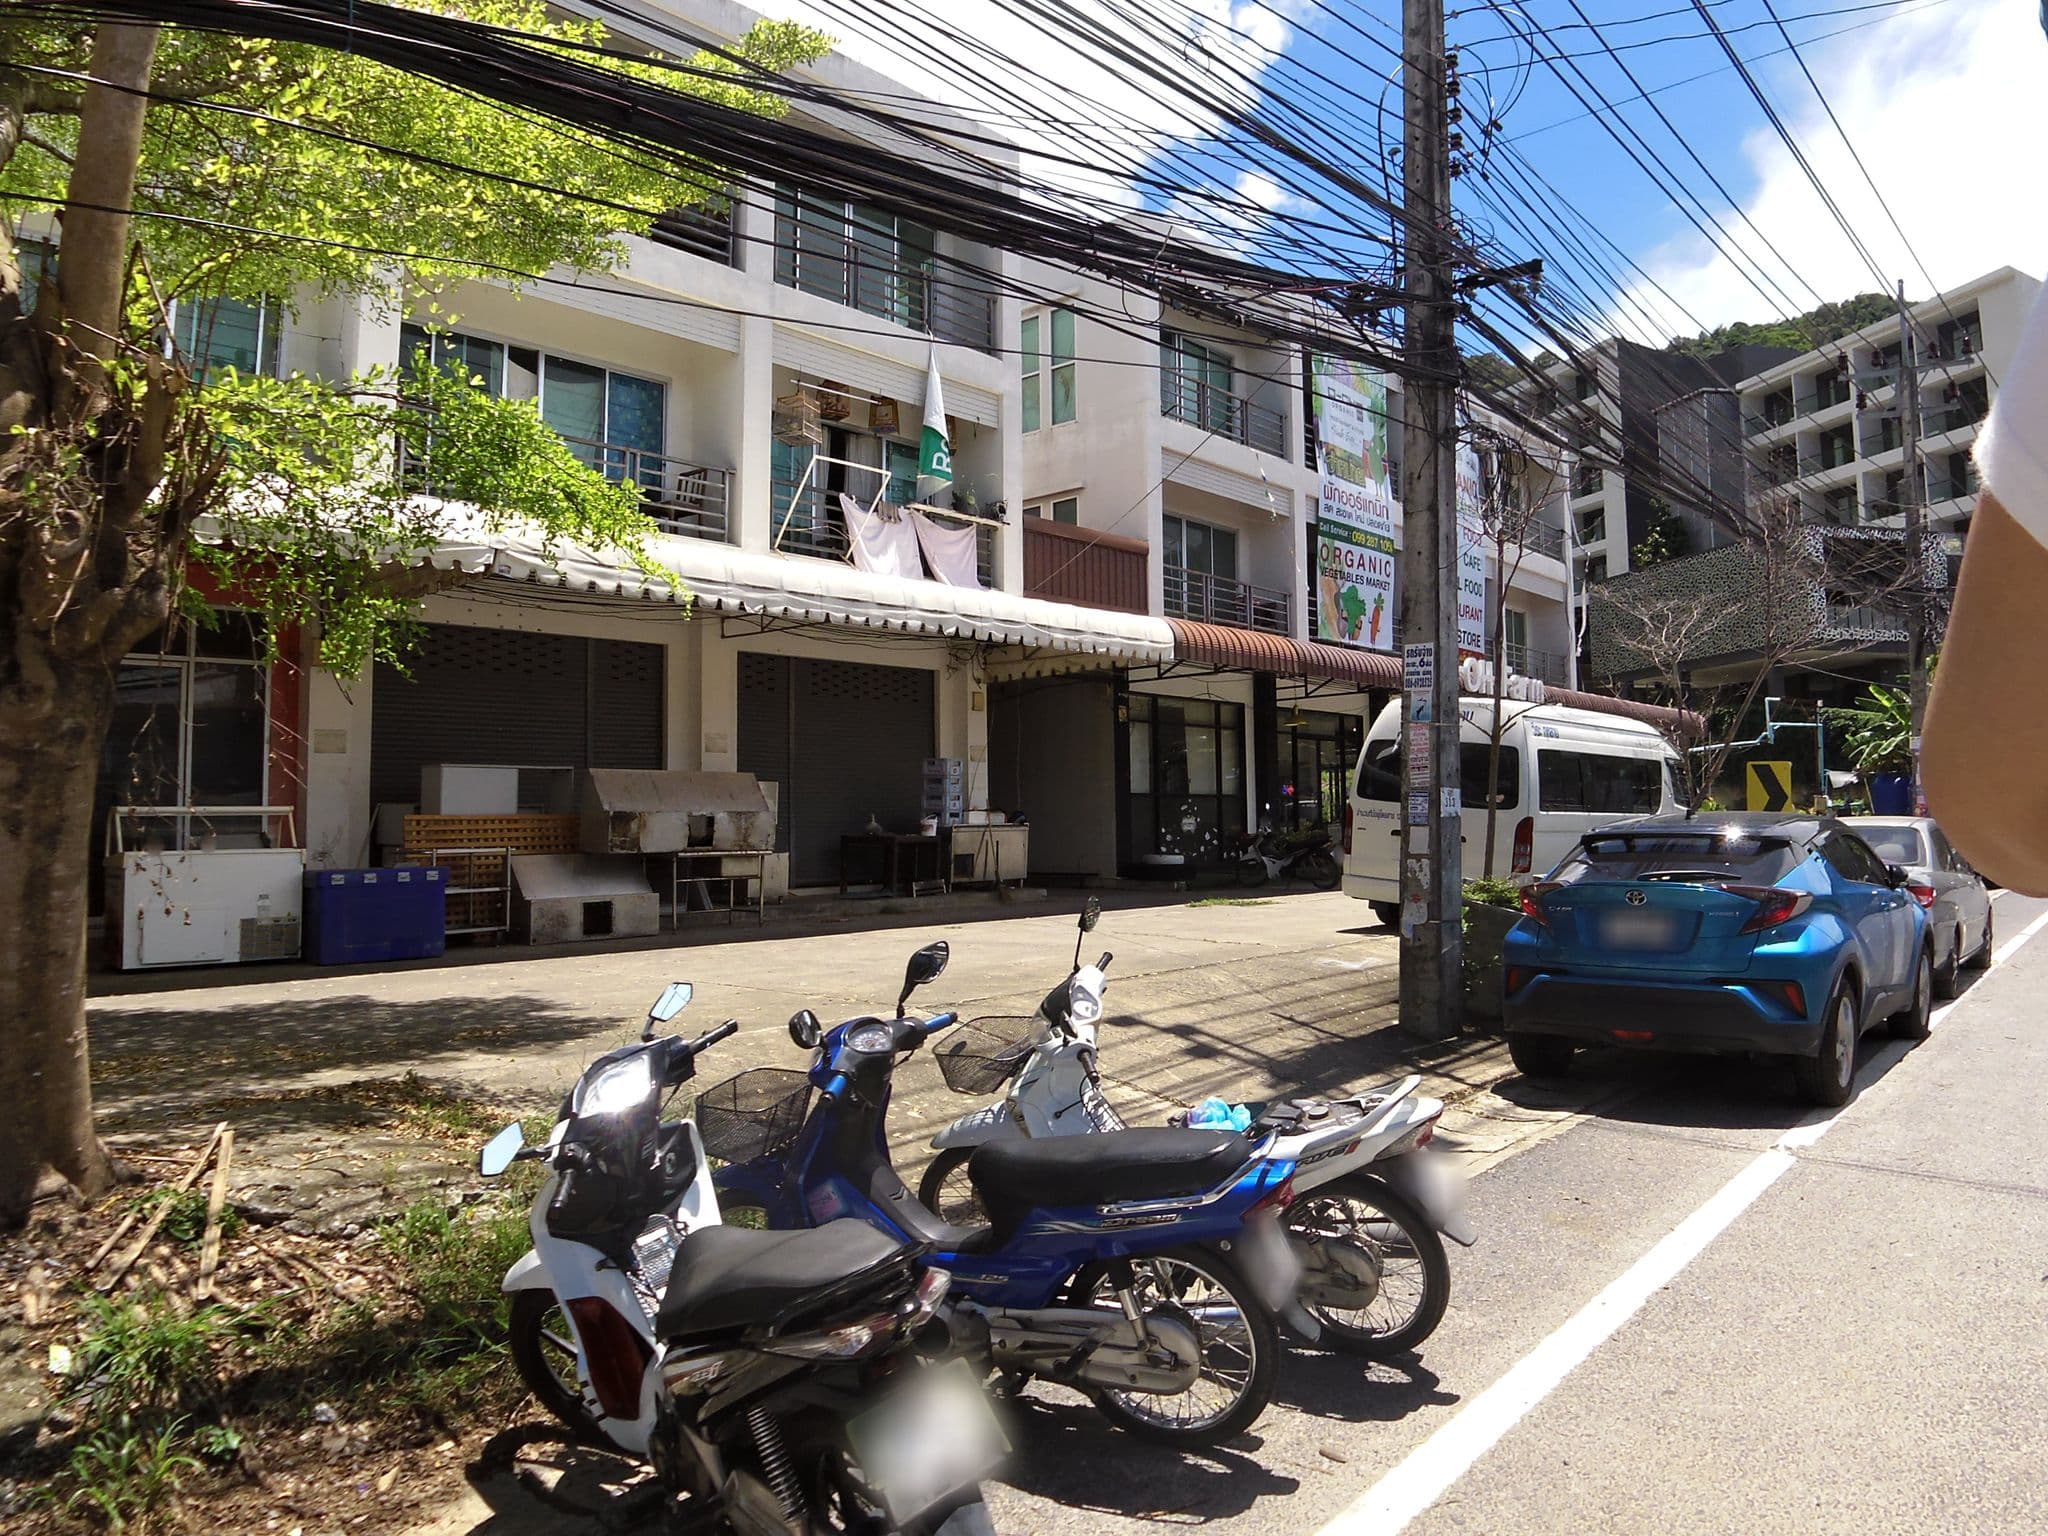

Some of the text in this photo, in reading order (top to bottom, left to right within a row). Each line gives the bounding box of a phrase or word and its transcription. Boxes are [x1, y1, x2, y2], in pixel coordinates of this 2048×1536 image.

[1320, 543, 1391, 578] ORGANIC
[1464, 552, 1481, 571] CAFE
[1321, 566, 1390, 591] VEGETABLES MARKET
[1464, 578, 1482, 597] FOOD
